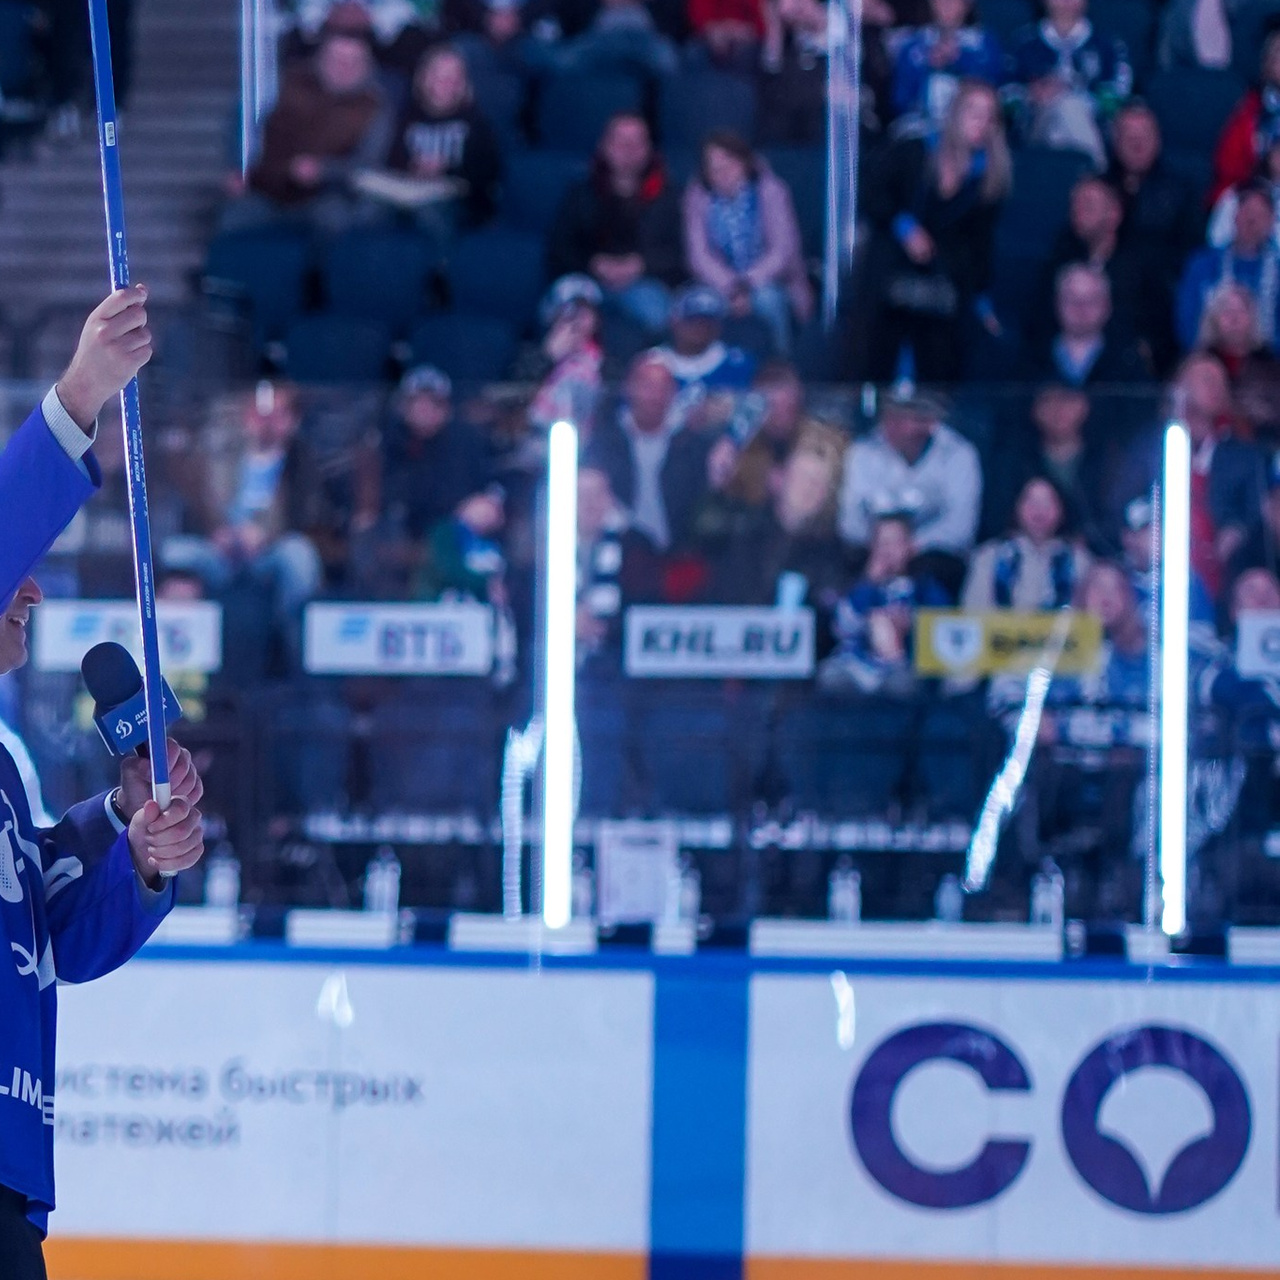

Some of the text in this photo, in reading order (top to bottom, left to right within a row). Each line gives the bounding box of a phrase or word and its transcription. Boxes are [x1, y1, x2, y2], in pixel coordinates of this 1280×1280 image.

[379, 620, 464, 661] ВТБ
[641, 620, 801, 659] KHL.RU
[218, 1056, 425, 1111] быстрых
[850, 1021, 1280, 1214] СО
